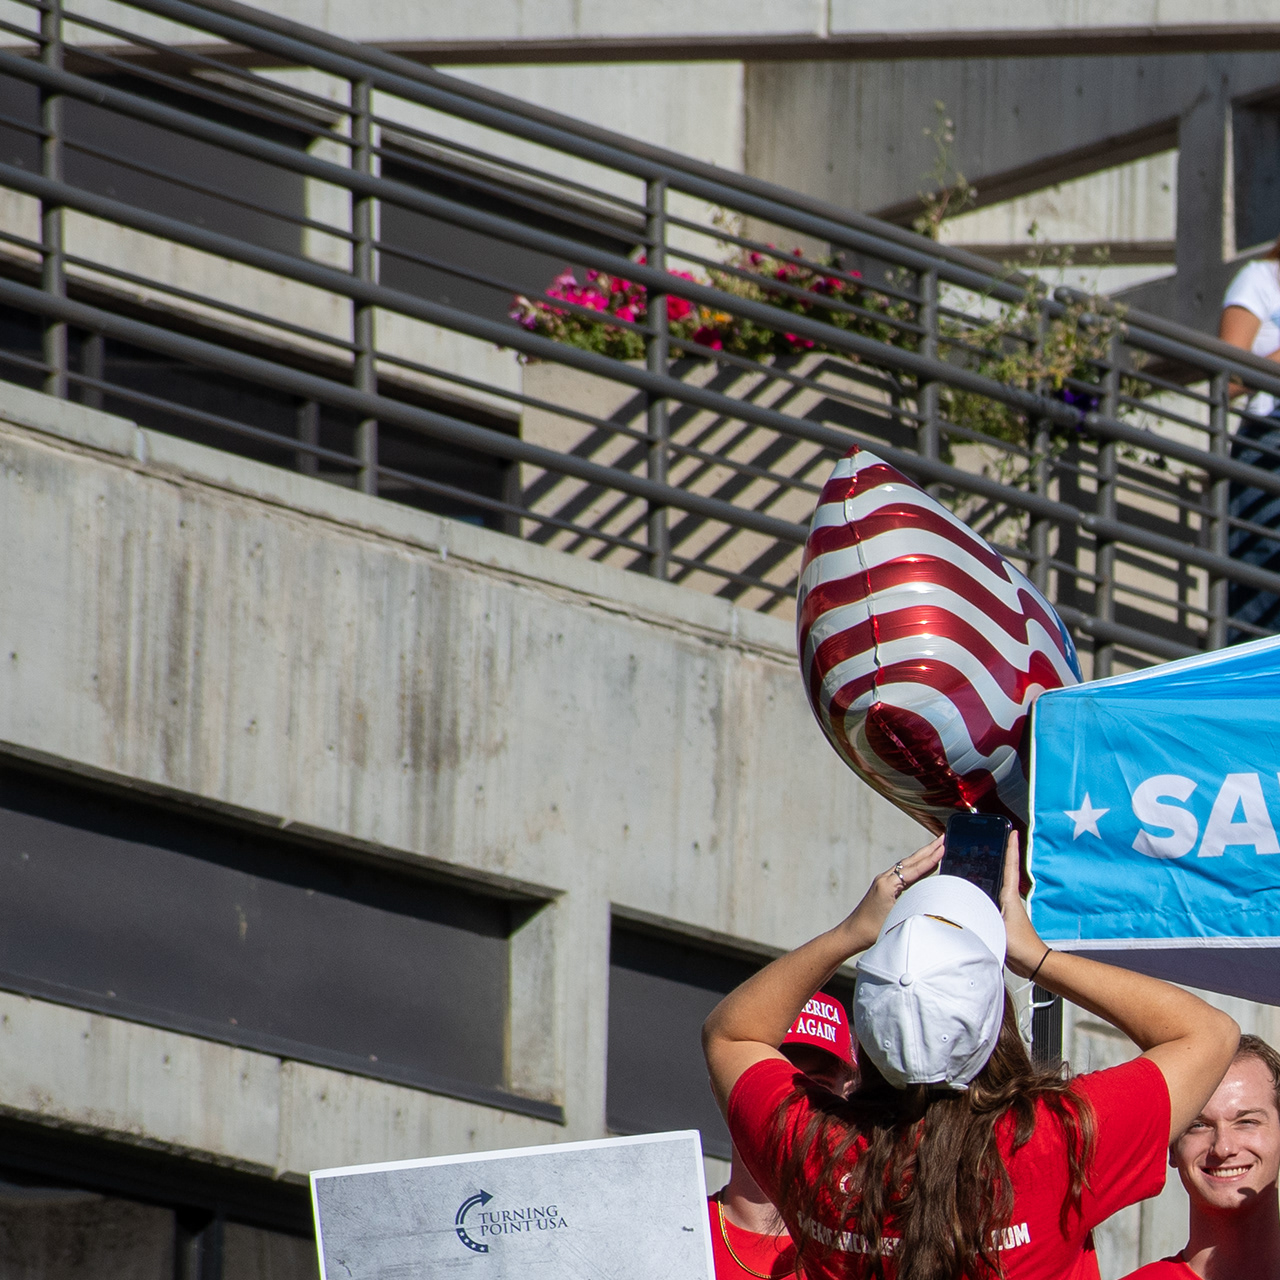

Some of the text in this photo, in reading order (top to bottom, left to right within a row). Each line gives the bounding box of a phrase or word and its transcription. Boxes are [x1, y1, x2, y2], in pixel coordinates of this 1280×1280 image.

[801, 999, 842, 1025] ERICA
[796, 1017, 837, 1043] AGAIN
[477, 1204, 559, 1226] TURNING
[480, 1216, 569, 1238] POINT USA
